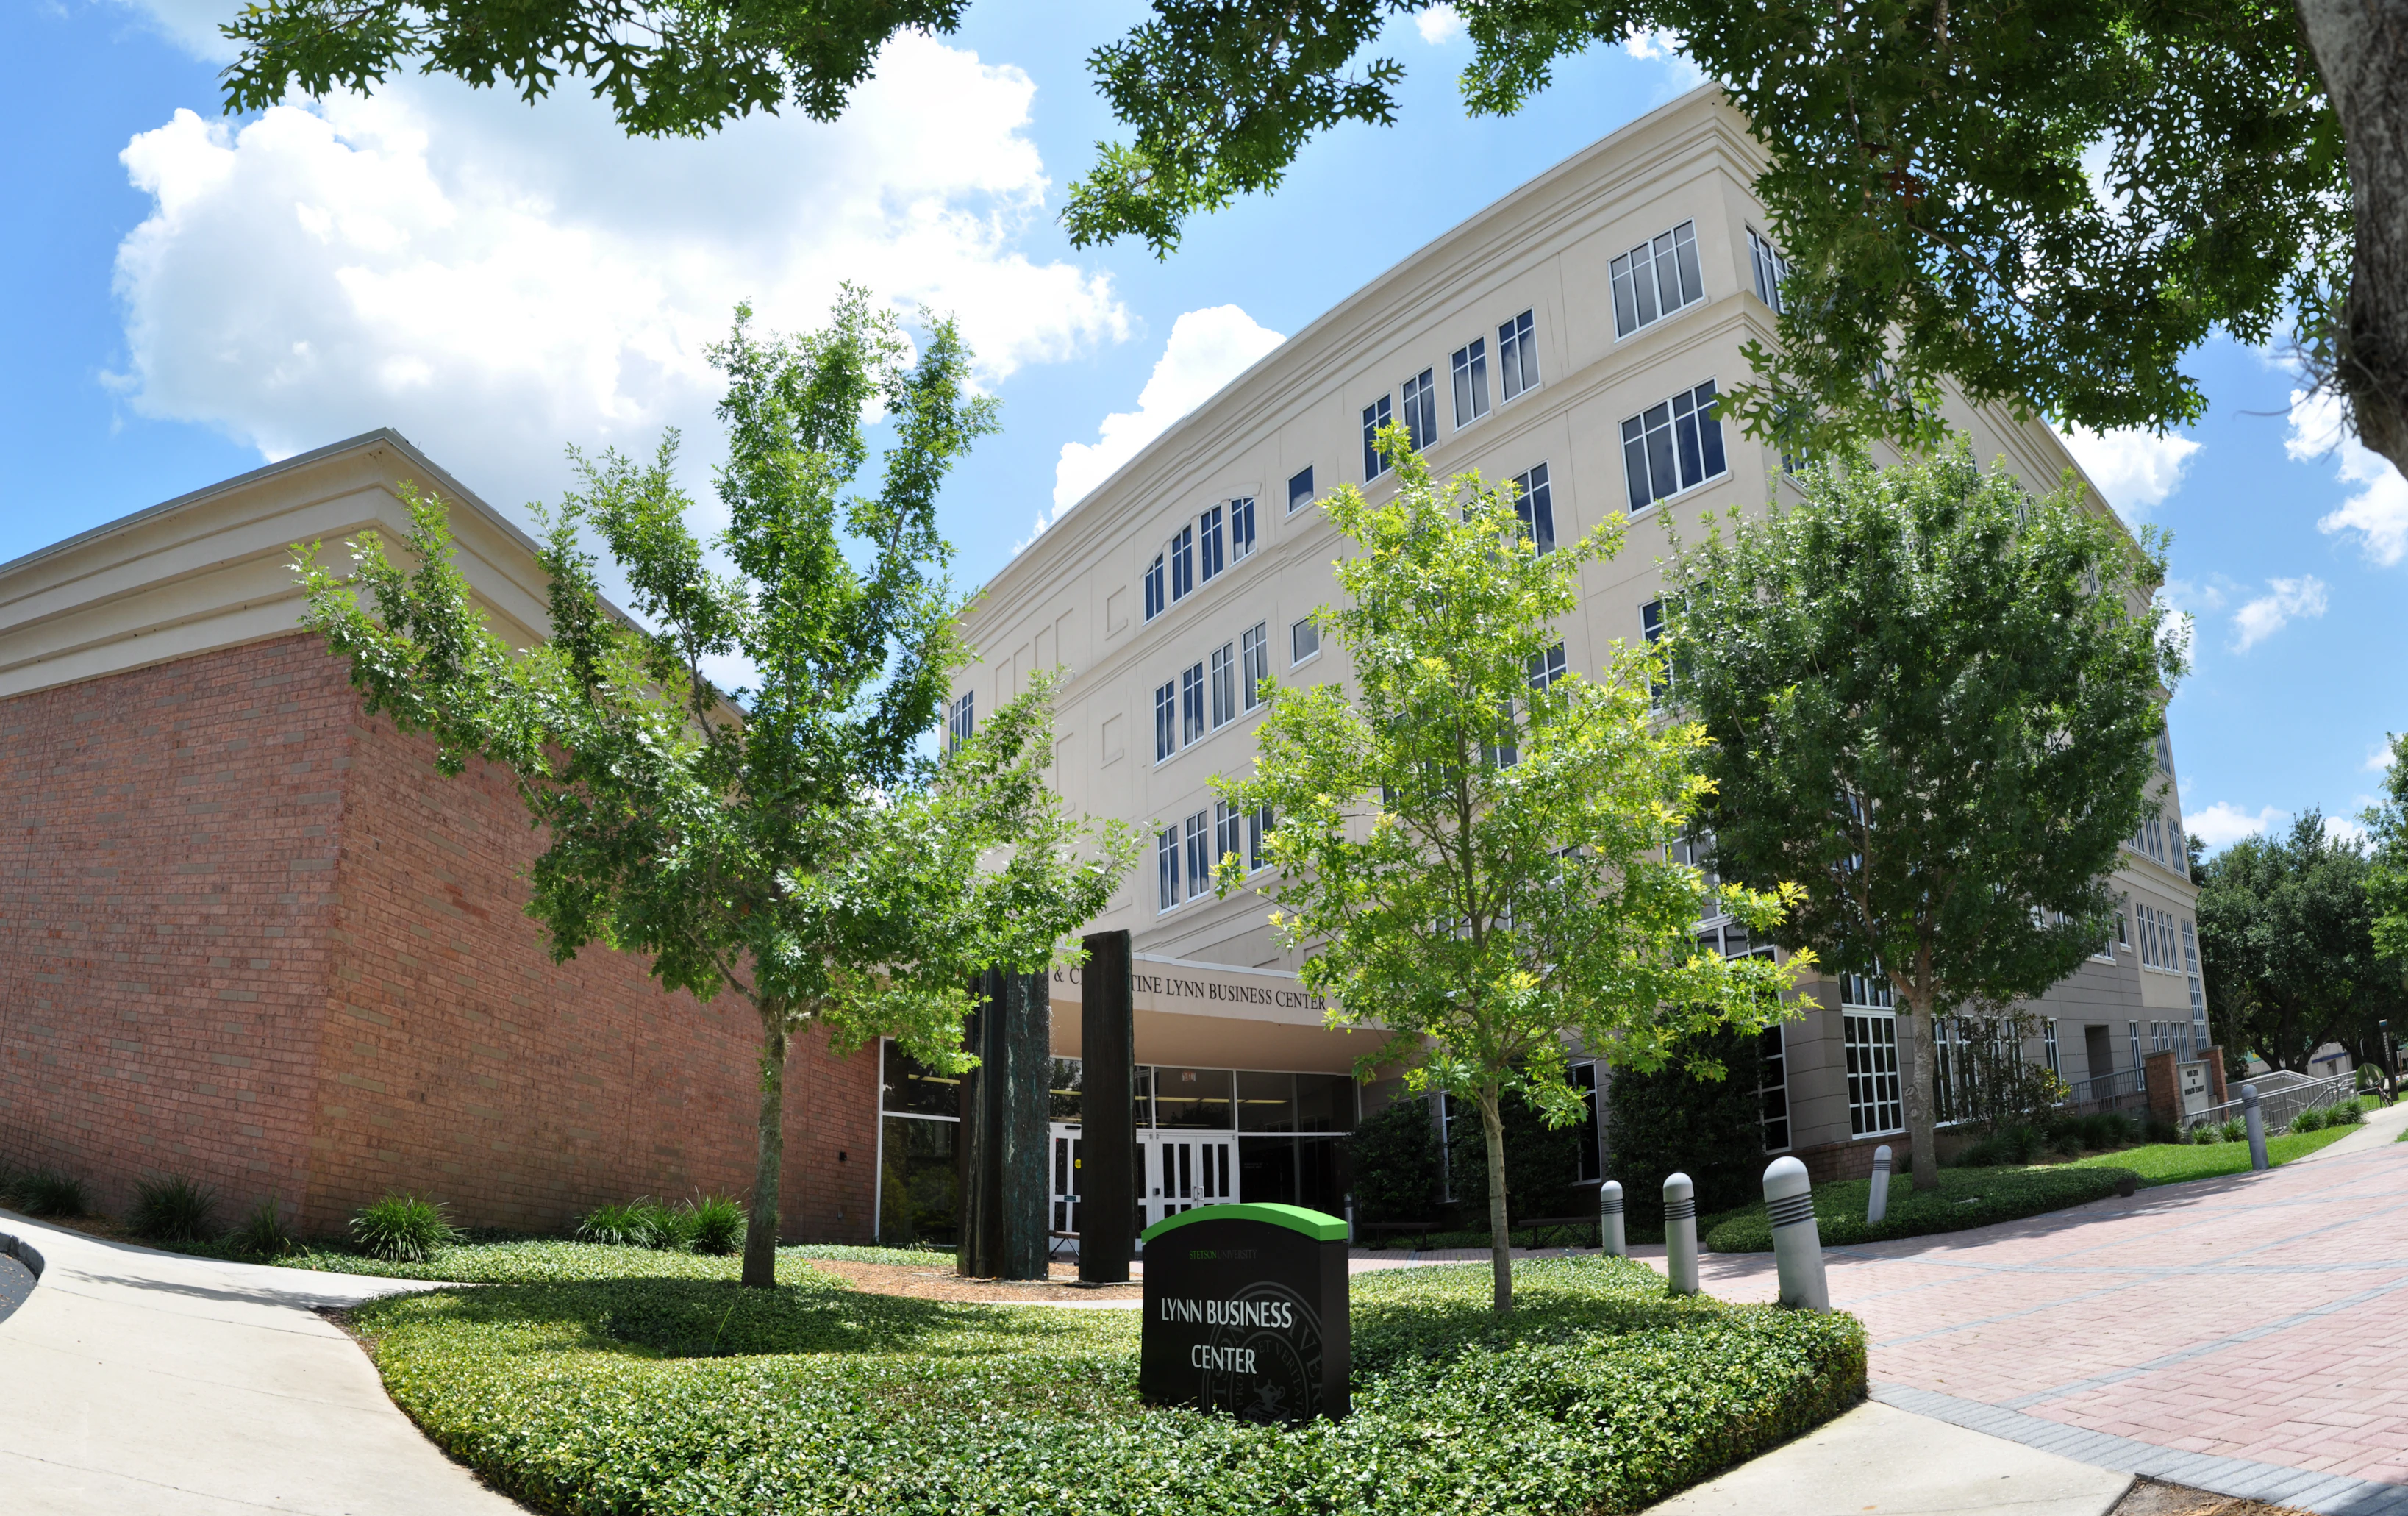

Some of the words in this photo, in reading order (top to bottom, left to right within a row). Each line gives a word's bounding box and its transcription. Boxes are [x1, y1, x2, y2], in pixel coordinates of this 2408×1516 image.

[1054, 966, 1064, 983] &
[1166, 979, 1204, 998] LYNN
[1209, 983, 1272, 1005] BUSINESS
[1276, 990, 1326, 1010] CENTER
[1162, 1298, 1202, 1323] LYNN
[1207, 1300, 1293, 1328] BUSINESS
[1191, 1345, 1257, 1375] CENTER
